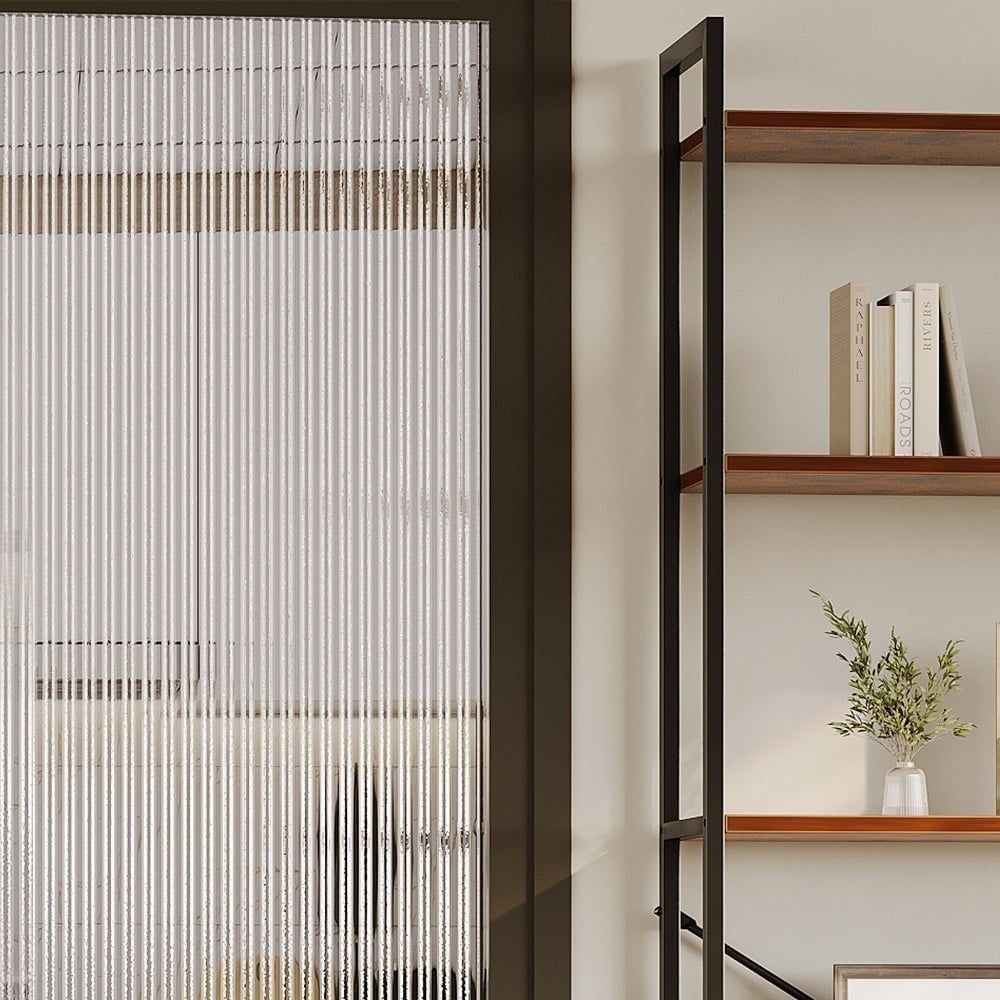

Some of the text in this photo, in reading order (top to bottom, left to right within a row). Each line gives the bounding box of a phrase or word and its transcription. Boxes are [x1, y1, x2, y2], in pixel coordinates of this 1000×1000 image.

[856, 297, 864, 383] RAPHAEL
[923, 301, 931, 350] RIVERS
[899, 386, 911, 448] ROADS
